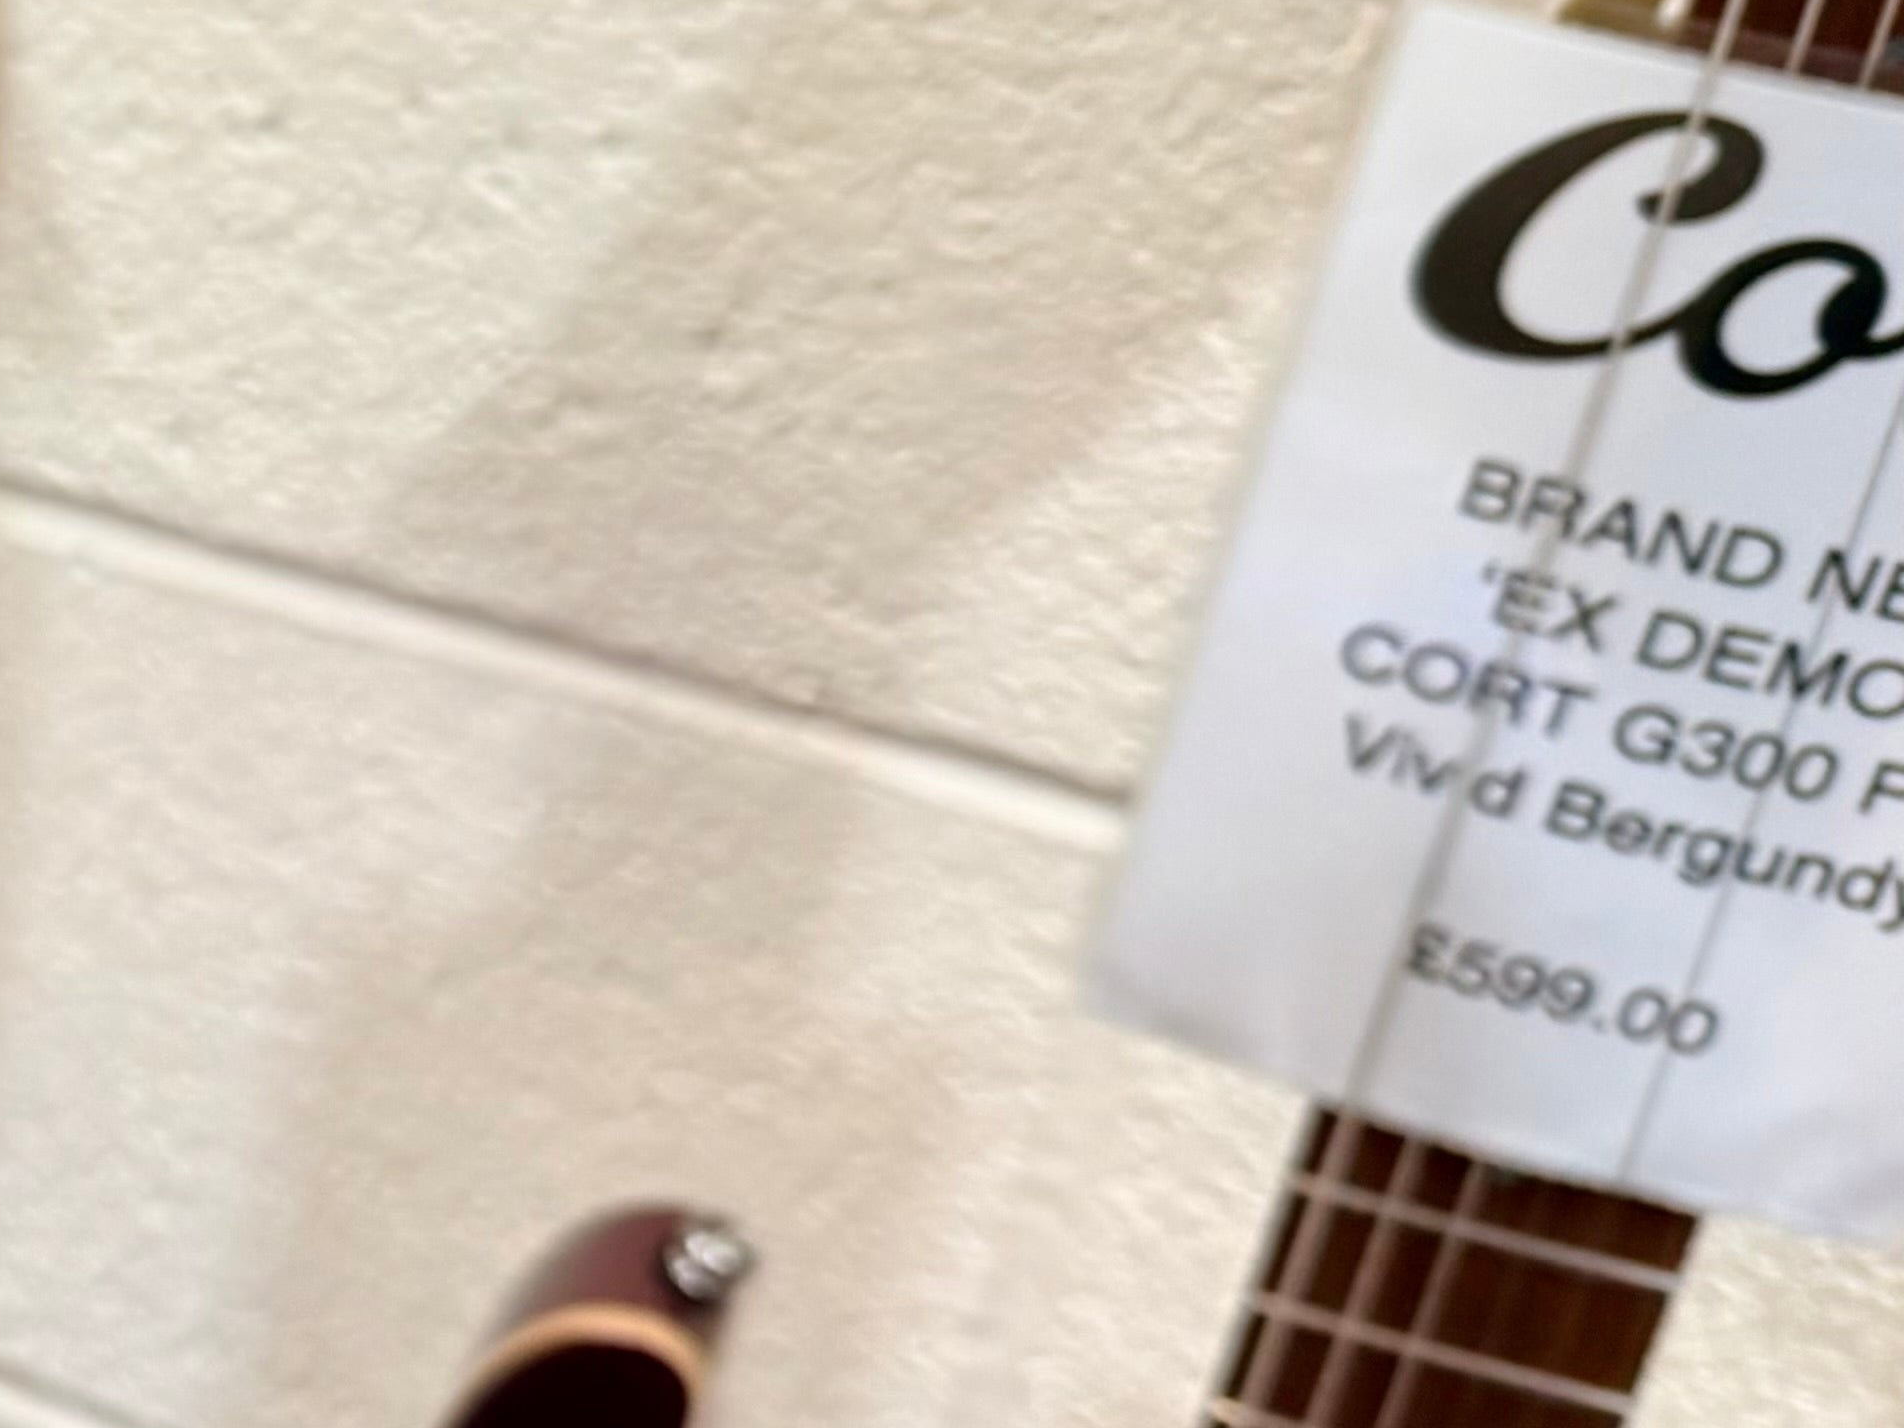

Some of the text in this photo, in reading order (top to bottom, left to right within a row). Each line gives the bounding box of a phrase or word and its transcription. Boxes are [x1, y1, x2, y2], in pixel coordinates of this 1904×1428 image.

[1409, 107, 1904, 402] Co
[1459, 456, 1904, 623] BRAND NE
[1339, 621, 1596, 738] CORT
[1612, 702, 1839, 802] G300
[1343, 712, 1527, 819] Vivd
[1406, 920, 1718, 1055] £599.00
